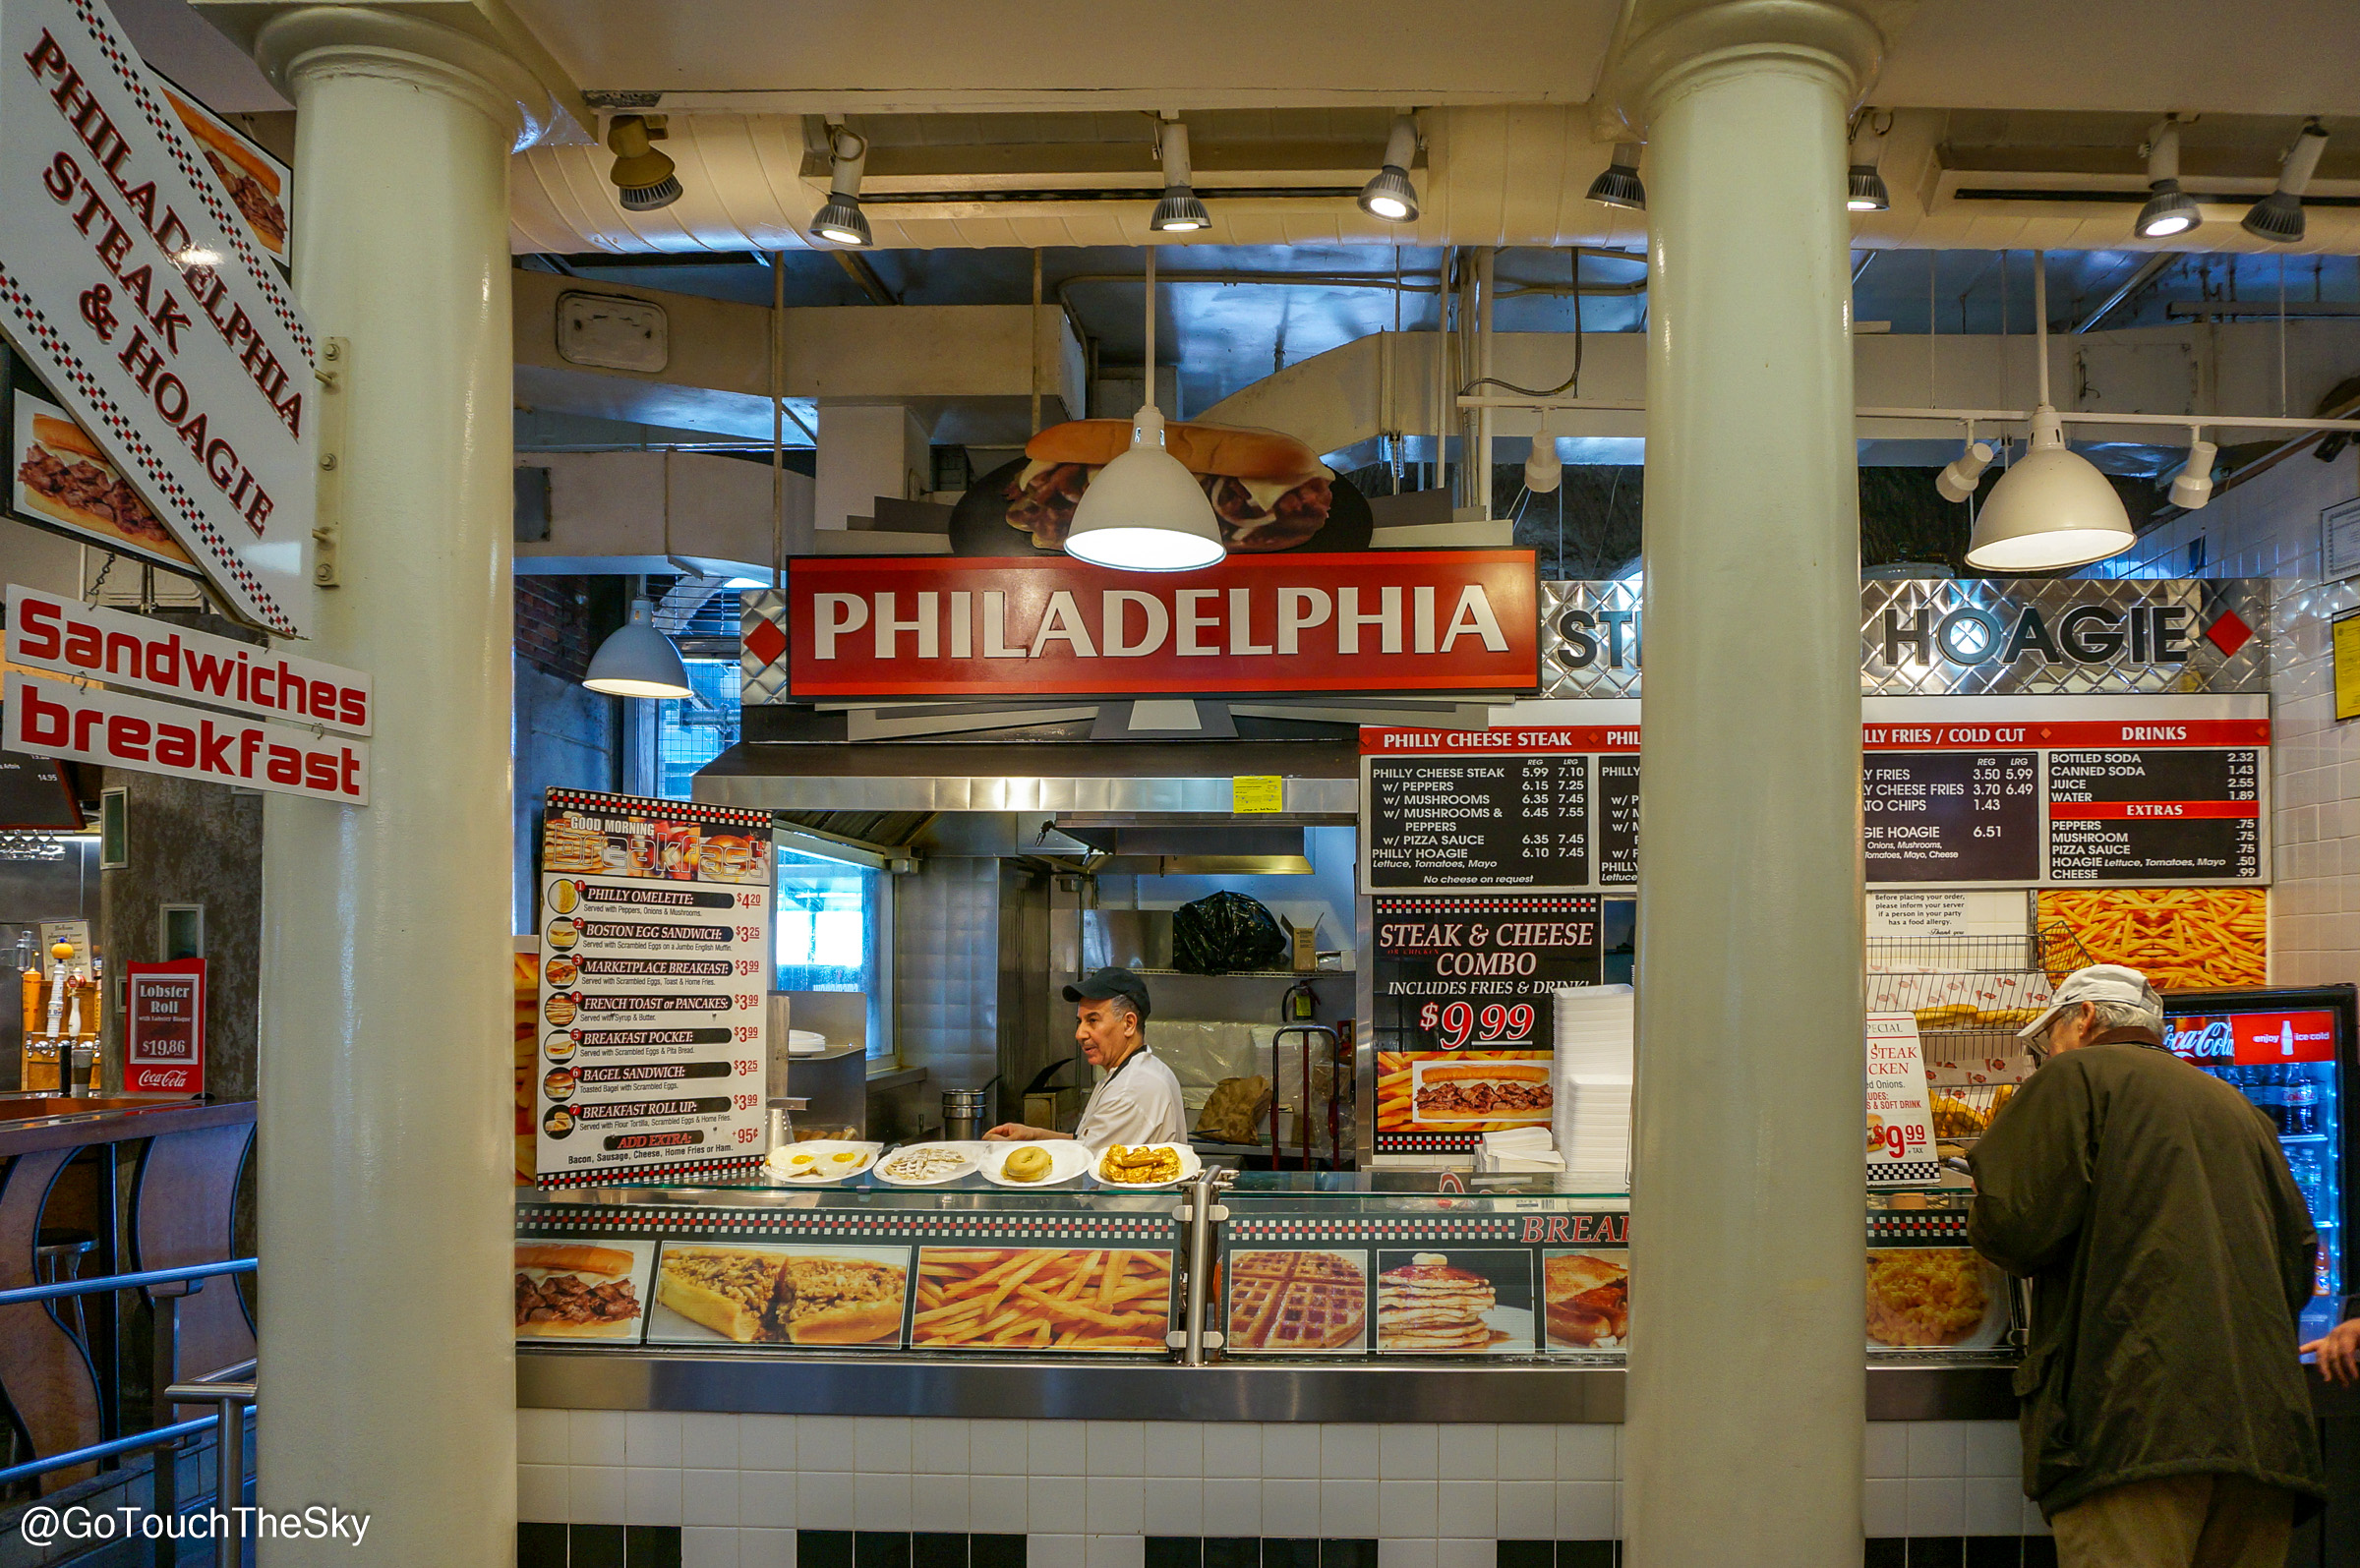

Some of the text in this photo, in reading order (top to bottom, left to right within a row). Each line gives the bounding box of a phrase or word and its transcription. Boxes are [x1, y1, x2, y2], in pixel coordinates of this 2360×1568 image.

[23, 27, 304, 442] PHILADELPHIA
[42, 148, 195, 354] STEAK
[77, 282, 274, 539] & HOAGIE
[813, 586, 1509, 662] PHILADELPHIA
[1883, 605, 2188, 668] HOAGIE
[19, 598, 368, 726] Sandwiches
[19, 682, 361, 796] breakfast
[1892, 727, 2026, 742] FRIES COLD CUT
[2122, 726, 2187, 740] DRINKS
[1384, 732, 1571, 747] PHILLY CHEESE STEAK
[2051, 753, 2254, 763] BOTTLED SODA 2.32
[1373, 768, 1584, 778] PHILLY CHEESE STEAK 5.99 7.10
[1876, 769, 2033, 780] FRIES 3.50 5.99
[2051, 766, 2254, 776] CANNED SODA 1.43
[1402, 781, 1584, 791] PEPPERS 6.15 7.25
[1876, 784, 2033, 795] CHEESE FRIES 3.70 6.49
[2051, 779, 2254, 788] JUICE 2.55
[1404, 794, 1584, 804] MUSHROOMS 6.35 7.45
[2051, 791, 2255, 802] WATER 1.89
[1887, 799, 2000, 811] CHIPS 1.43
[2127, 805, 2183, 815] EXTRAS
[1404, 808, 1584, 818] MUSHROOMS & 6.45 7.55
[571, 816, 654, 836] GOOD MORNING
[1405, 822, 1456, 832] PEPPERS
[1888, 826, 2002, 838] HOAGIE 6.51
[2052, 821, 2101, 831] PEPPERS
[1403, 835, 1584, 845] PIZZA SAUCE 6.35 7.45
[2052, 834, 2128, 842] MUSHROOM
[1372, 848, 1584, 858] PHILLY HOAGIE 6.10 7.45
[2052, 845, 2086, 854] PIZZA
[2089, 845, 2130, 854] SAUCE
[1373, 859, 1497, 869] Lettuce, Tomatoes, Mayo
[2052, 857, 2102, 867] HOAGIE
[2104, 858, 2143, 867] Lettuce,
[2146, 858, 2195, 867] Tomatoes,
[2197, 858, 2226, 867] Mayo
[1441, 875, 1477, 884] cheese
[1496, 875, 1533, 884] request
[2052, 870, 2097, 879] CHEESE
[587, 891, 693, 904] PHILLY OMELETTE:
[586, 924, 722, 940] BOSTON EGG SANDWICH:
[1380, 922, 1593, 947] STEAK & CHEESE
[584, 960, 729, 974] MARKETPLACE BREAKFAST:
[1437, 952, 1536, 976] COMBO
[140, 985, 190, 998] Lobster
[1388, 982, 1466, 995] INCLUDES
[1469, 981, 1513, 994] FRIES
[1517, 981, 1529, 994] &
[150, 1001, 178, 1013] Roll
[584, 998, 729, 1010] FRENCH TOAST or PANCAKES:
[583, 1032, 693, 1045] BREAKFAST POCKET:
[2253, 1034, 2279, 1043] enjoy
[143, 1040, 185, 1056] $19.86
[1870, 1047, 1918, 1059] STEAK
[583, 1067, 685, 1081] BAGEL SANDWICH:
[583, 1102, 696, 1119] BREAKFAST ROLL UP:
[1900, 1100, 1921, 1109] DRINK
[618, 1135, 691, 1149] ADD EXTRA:
[568, 1155, 594, 1164] Bacon,
[597, 1152, 631, 1163] Sausage,
[633, 1150, 663, 1160] Cheese,
[665, 1148, 685, 1158] Home
[716, 1144, 734, 1153] Ham.
